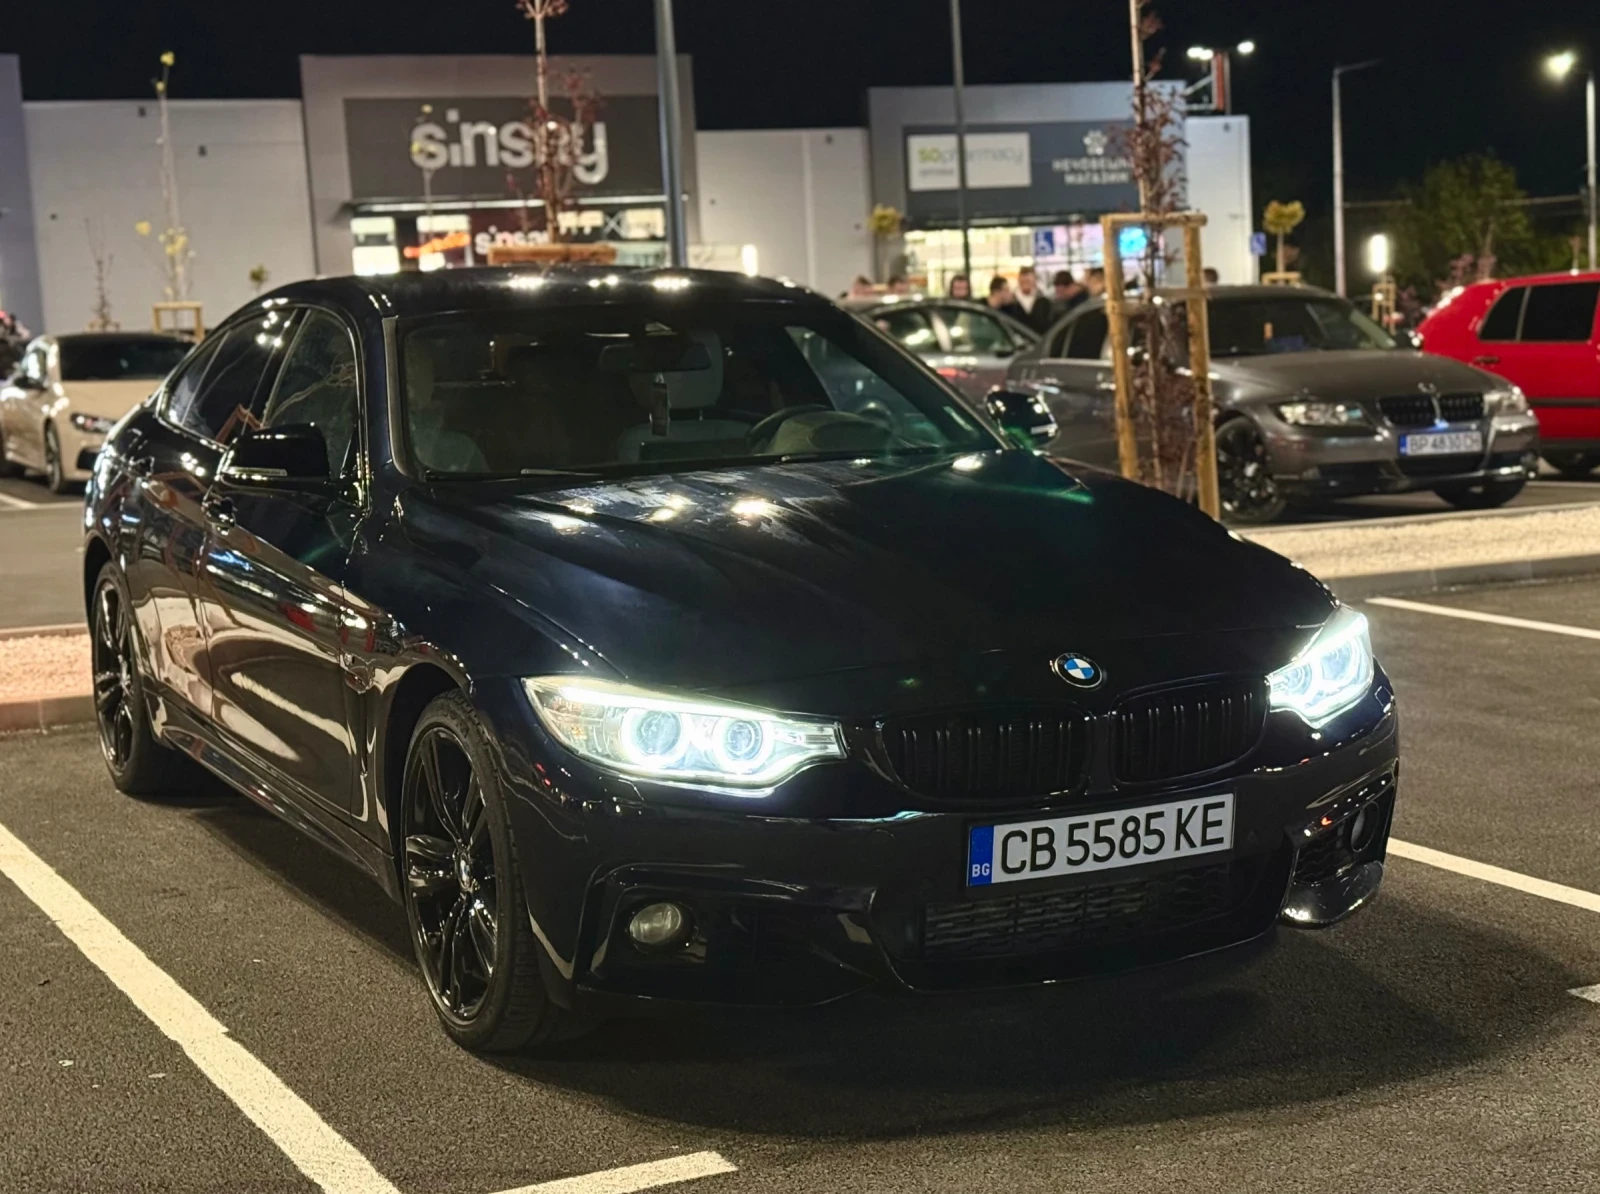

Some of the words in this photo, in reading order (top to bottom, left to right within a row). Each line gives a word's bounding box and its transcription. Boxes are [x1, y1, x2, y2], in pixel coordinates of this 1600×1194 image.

[1001, 826, 1057, 875] CB
[1066, 811, 1166, 866] 5585
[1174, 801, 1226, 851] KE
[972, 863, 990, 877] BG
